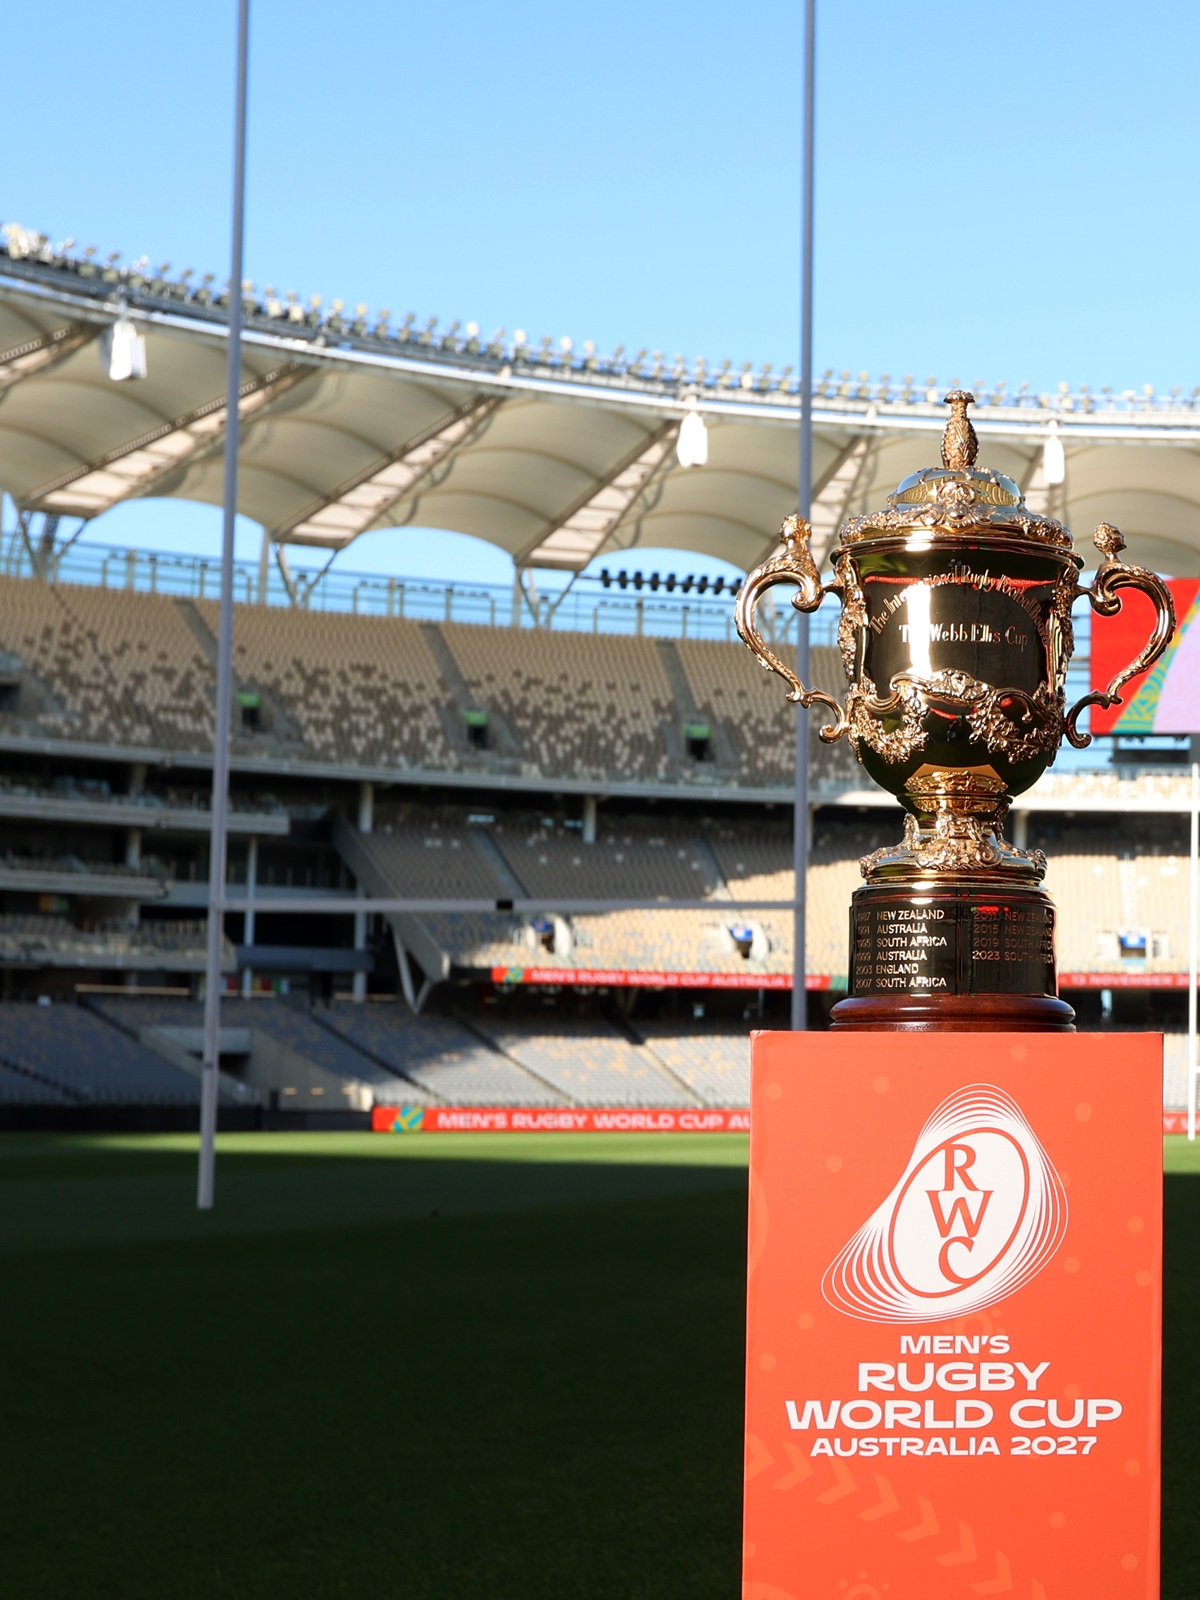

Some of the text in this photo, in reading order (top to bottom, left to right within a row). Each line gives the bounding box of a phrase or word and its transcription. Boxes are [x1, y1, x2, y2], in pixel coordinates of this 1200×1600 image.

[868, 610, 889, 634] The
[961, 565, 995, 592] Rugby
[930, 623, 968, 643] Webb
[970, 623, 1000, 643] Ellis
[1005, 625, 1028, 653] Cup
[877, 911, 896, 920] NEW
[898, 909, 944, 920] ZEALAND
[1004, 912, 1025, 921] NEW
[877, 923, 928, 933] AUSTRALIA
[973, 924, 999, 934] 2015
[1004, 925, 1025, 935] NEW
[877, 937, 907, 947] SOUTH
[909, 936, 947, 947] AFRICA
[973, 938, 999, 947] 2019
[1005, 939, 1034, 948] SOUTH
[877, 950, 927, 960] AUSTRALIA
[972, 950, 1000, 960] 2023
[1004, 952, 1034, 962] SOUTH
[876, 963, 919, 974] ENGLAND
[531, 970, 821, 988] MEN'S RUGBY WORLD CUP AUSTRALIA 227
[876, 977, 907, 988] SOUTH
[909, 976, 947, 987] AFRICA
[438, 1112, 507, 1128] MEN'S
[511, 1113, 588, 1129] RUGBY
[592, 1114, 676, 1129] WORLD
[679, 1114, 724, 1129] CUP
[925, 1143, 994, 1285] RWC
[900, 1335, 1011, 1354] MEN'S
[858, 1362, 1051, 1392] RUGBY
[784, 1398, 1123, 1430] WORLD CUP
[810, 1436, 1098, 1457] AUSTRALIA 2027
